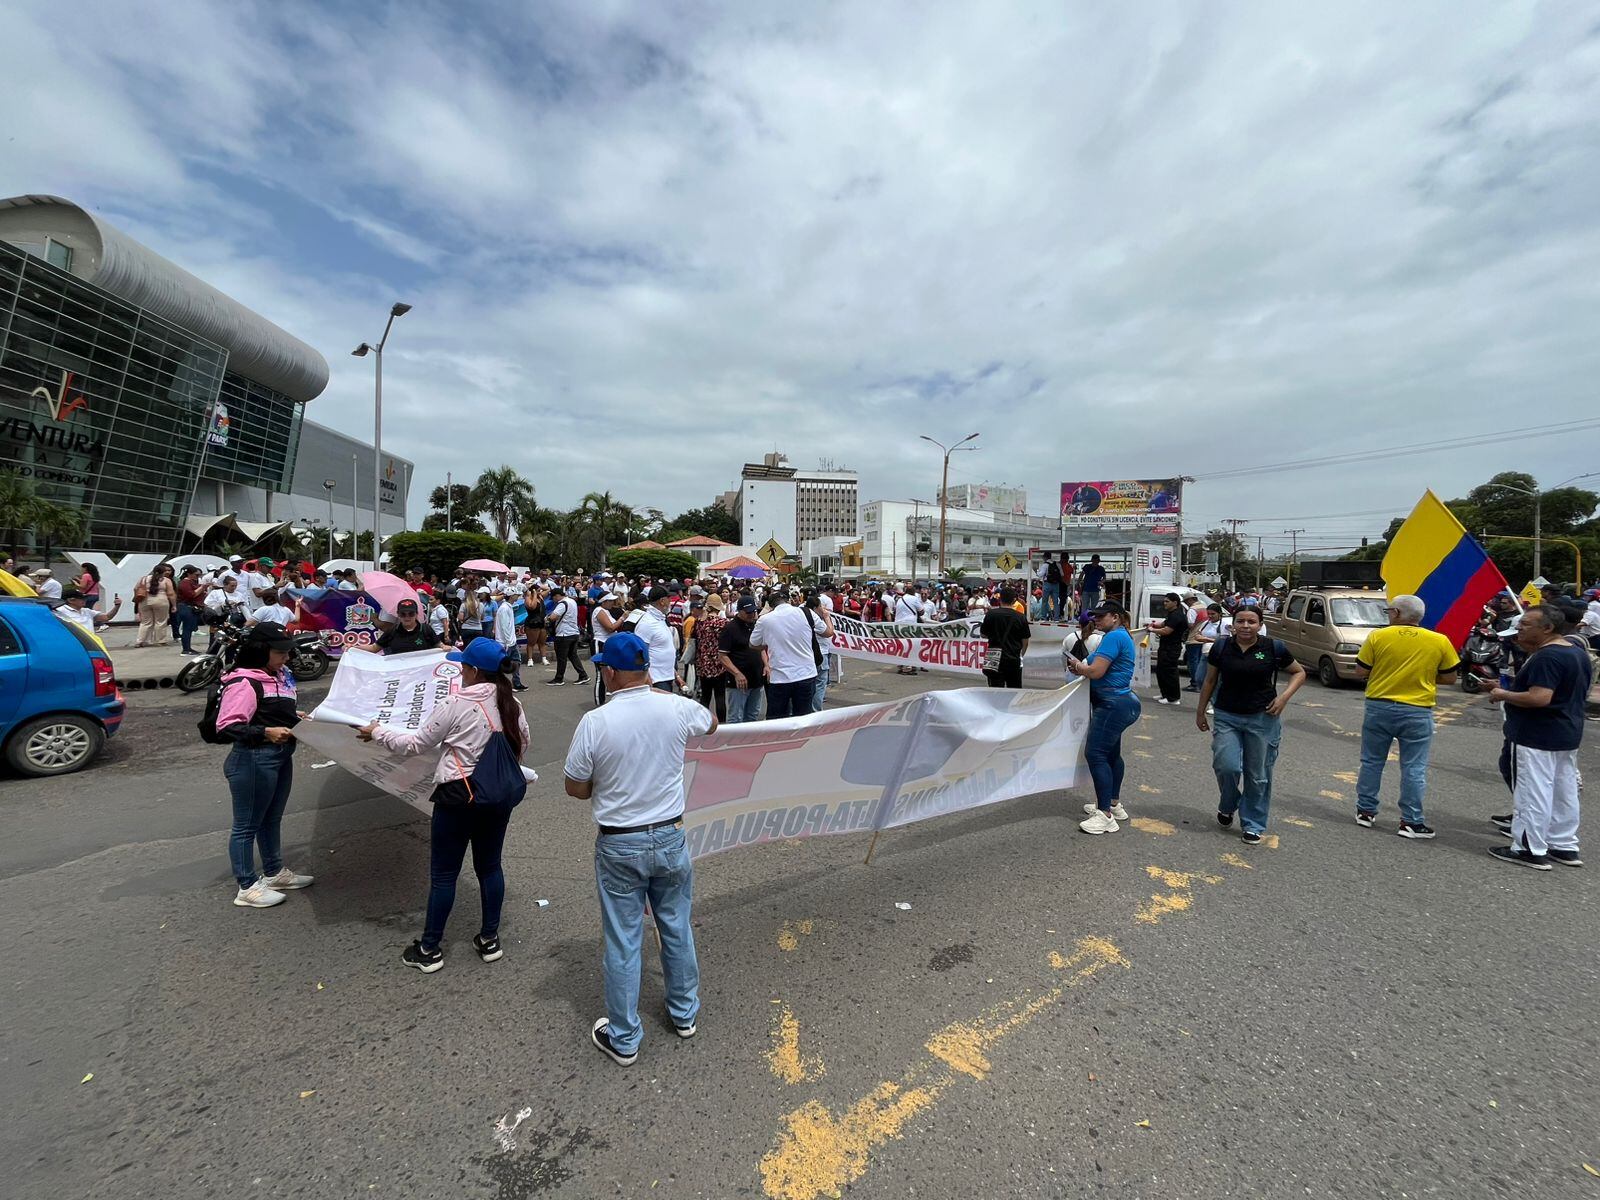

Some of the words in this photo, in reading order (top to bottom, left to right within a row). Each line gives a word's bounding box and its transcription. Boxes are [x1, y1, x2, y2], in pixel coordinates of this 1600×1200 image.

[329, 632, 371, 646] DOS
[376, 680, 400, 708] Laboral
[402, 680, 427, 729] rabajadores.
